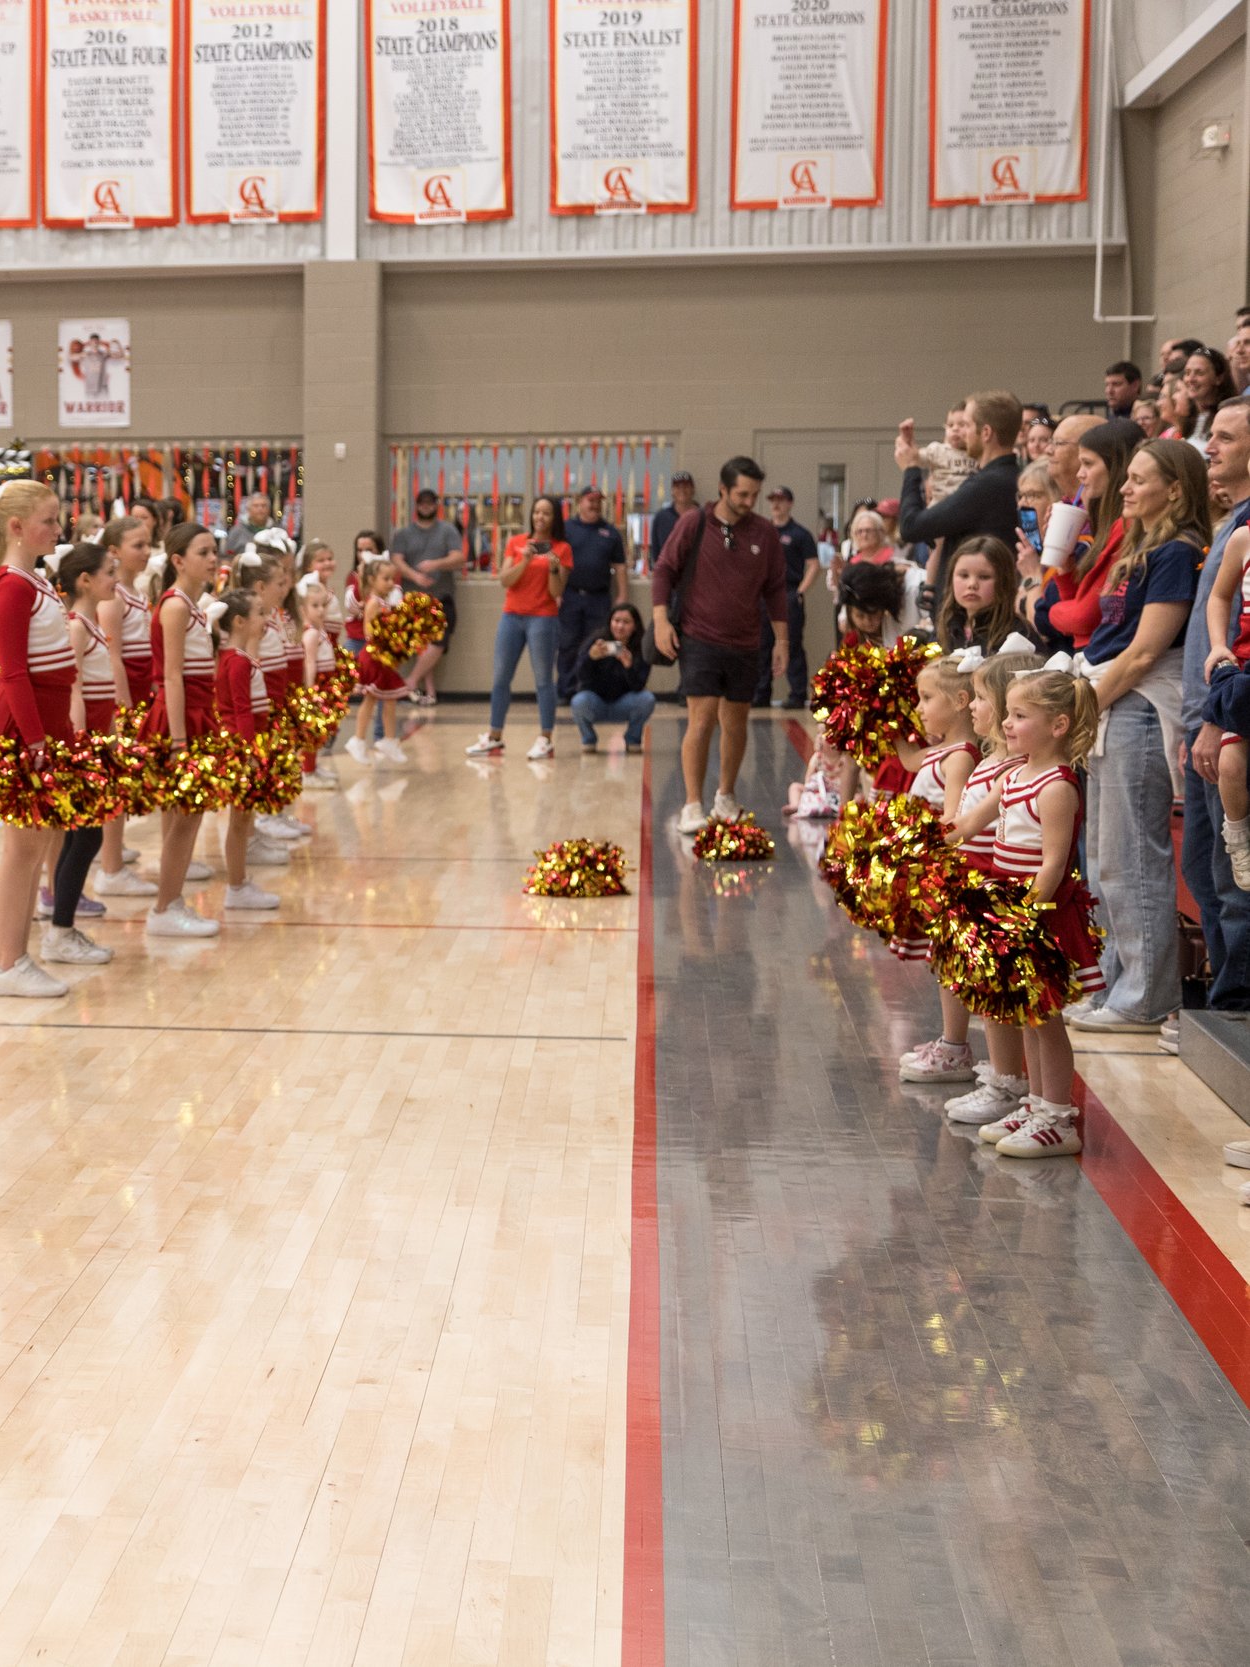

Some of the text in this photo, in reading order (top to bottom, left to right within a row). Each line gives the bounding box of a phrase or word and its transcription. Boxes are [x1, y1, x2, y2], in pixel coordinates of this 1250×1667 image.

[69, 10, 154, 24] BASKETBALL
[209, 4, 303, 17] VOLLEYBALL
[952, 2, 1069, 20] STATE CHAMPIONS
[417, 18, 459, 33] 2018
[599, 11, 642, 26] 2019
[754, 12, 866, 28] STATE CHAMPIONS
[85, 30, 127, 44] 2016
[231, 24, 273, 39] 2012
[563, 28, 683, 48] STATE FINALIST
[376, 30, 498, 56] STATE CHAMPIONS
[51, 48, 168, 67] STATE FINAL FOUR
[194, 40, 314, 63] STATE CHAMPIONS
[64, 400, 126, 415] WARRIOR
